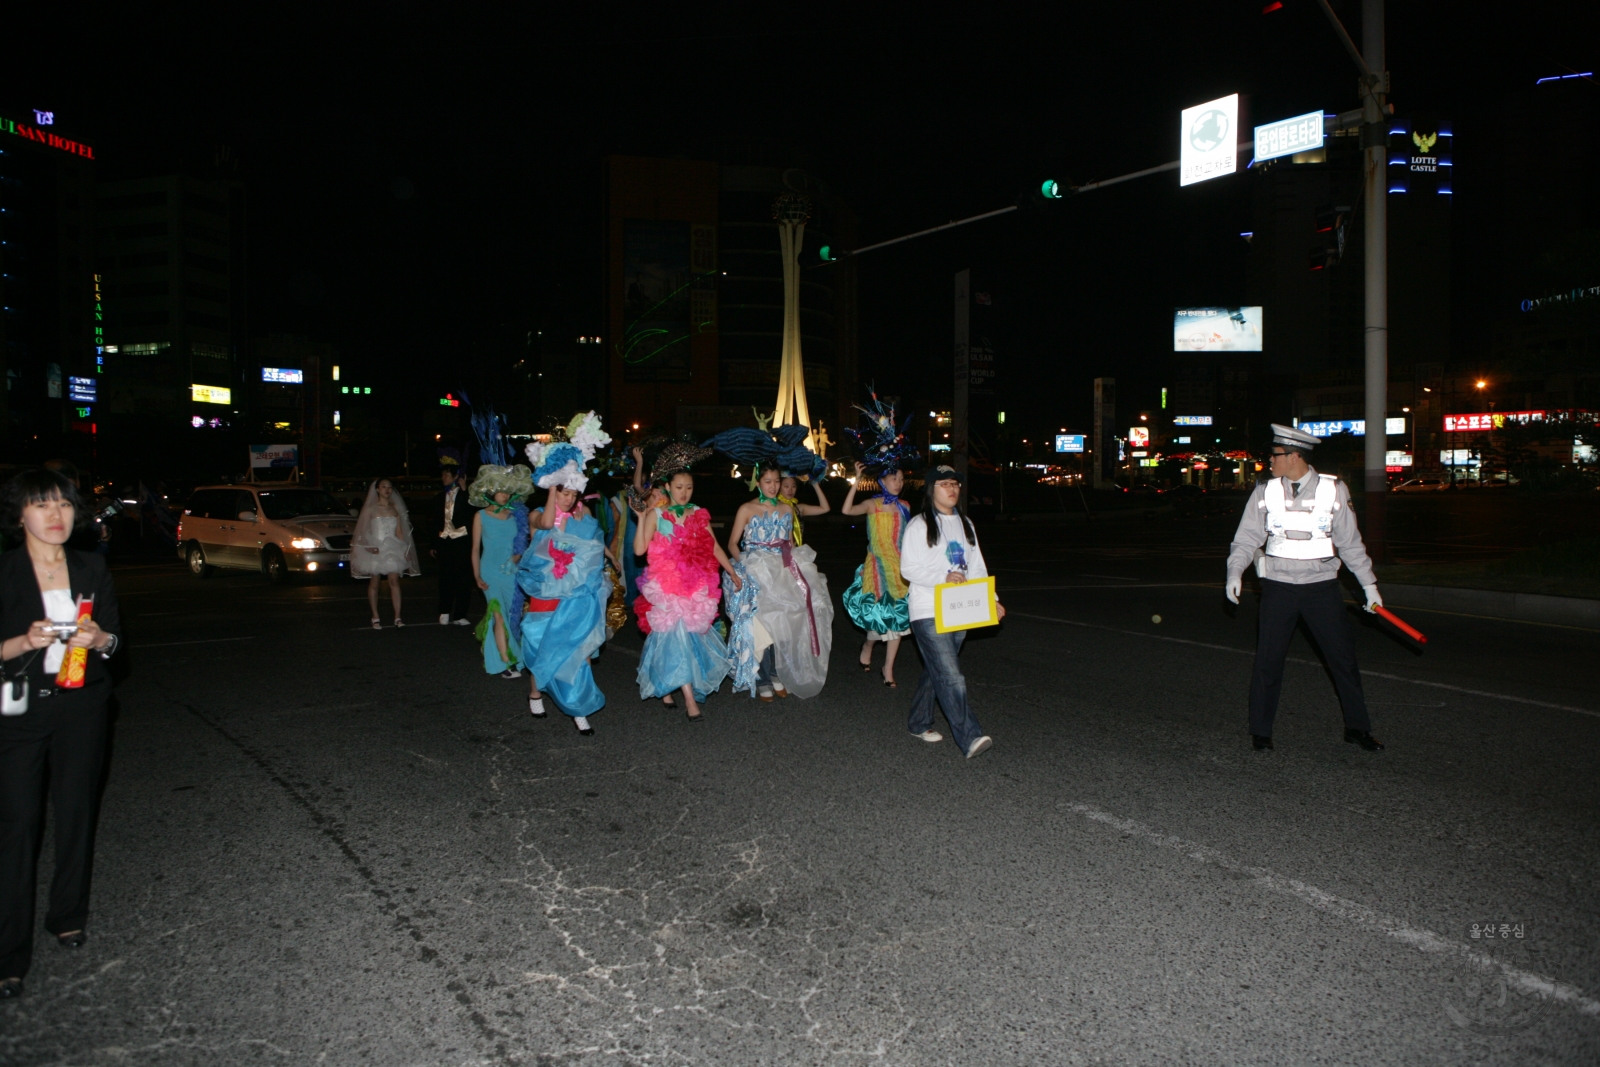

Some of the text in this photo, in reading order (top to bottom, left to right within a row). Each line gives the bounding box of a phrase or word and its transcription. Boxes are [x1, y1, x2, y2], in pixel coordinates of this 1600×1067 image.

[0, 117, 95, 160] ULSAN HOTEL
[1258, 118, 1320, 155] 공업탑로타리
[1184, 156, 1233, 180] 회전교차로
[1410, 164, 1437, 173] CASTLE
[1411, 157, 1437, 165] LOTTE
[94, 273, 104, 374] ULSAN HOTEL
